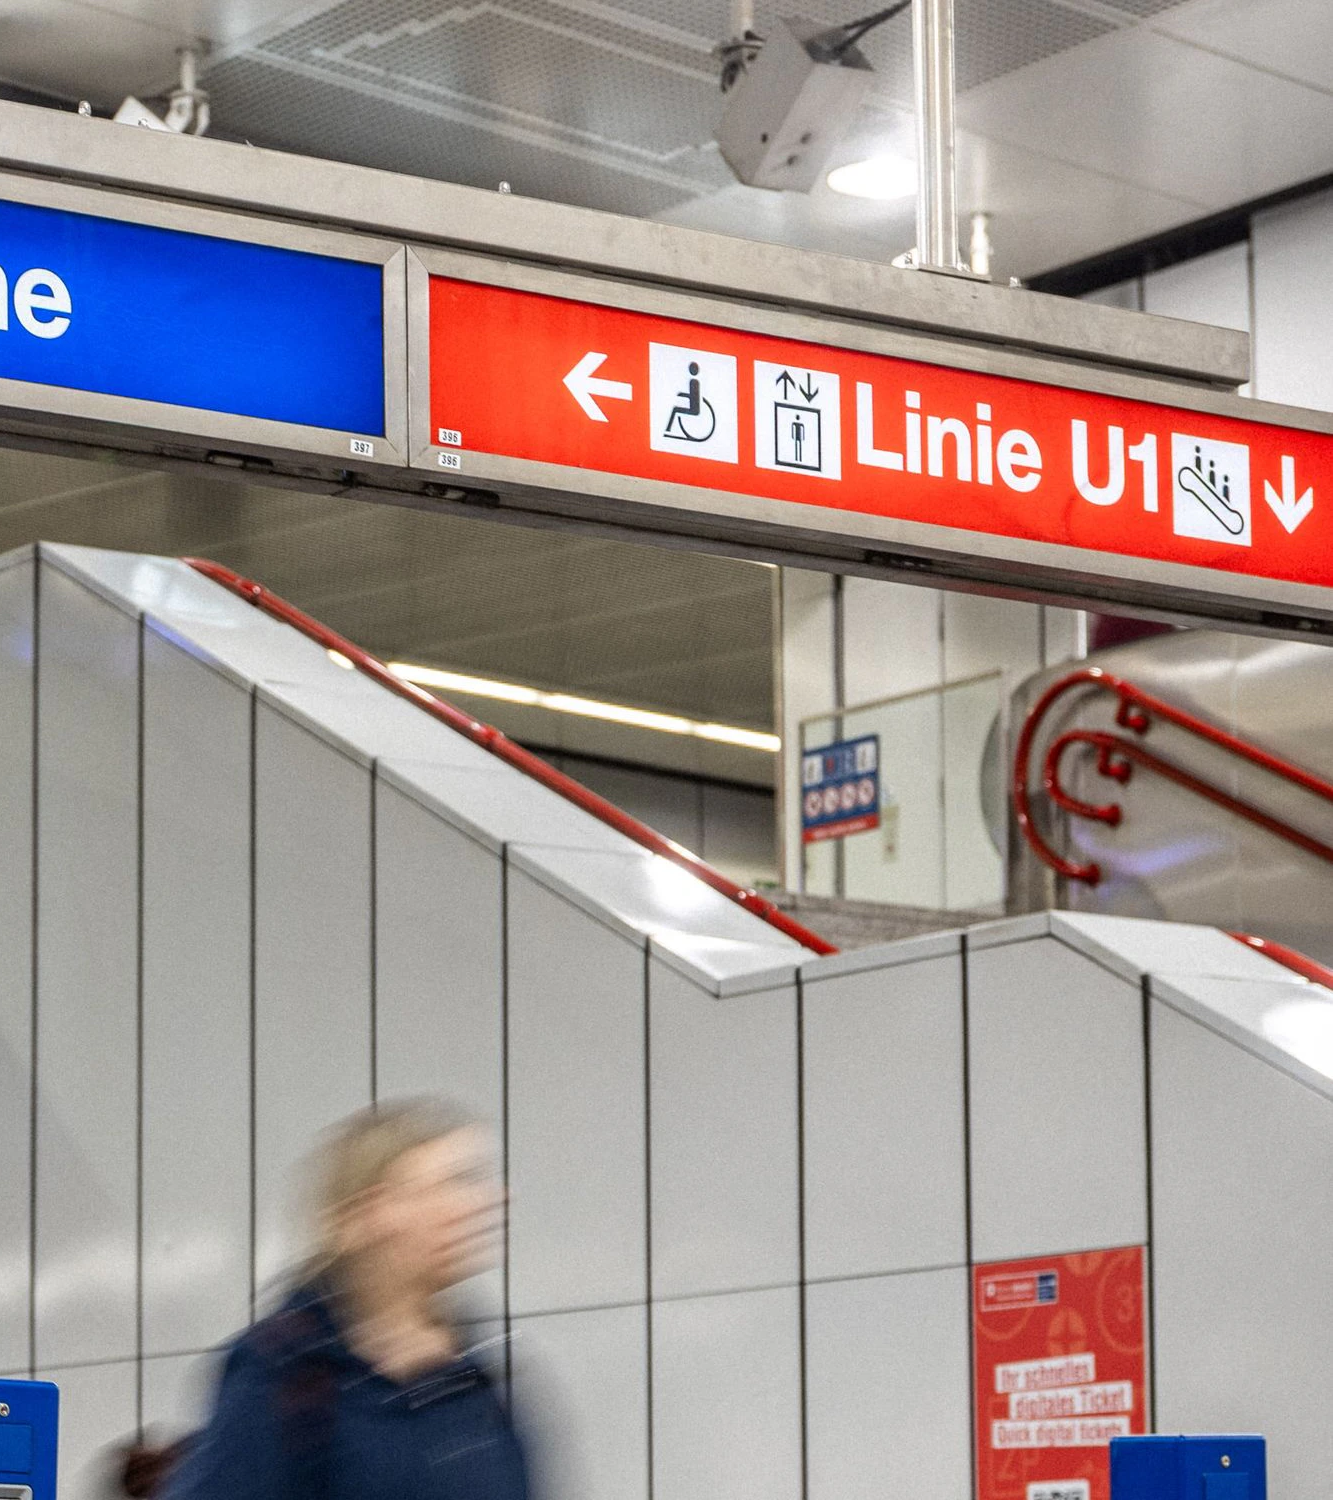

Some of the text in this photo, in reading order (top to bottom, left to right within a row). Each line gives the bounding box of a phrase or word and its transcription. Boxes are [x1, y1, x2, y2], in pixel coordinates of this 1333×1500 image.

[354, 441, 370, 454] 397
[856, 381, 1158, 513] Linie U1
[1001, 1362, 1089, 1389] Ihr schnelles
[1016, 1387, 1125, 1419] digitales Ticket
[998, 1422, 1122, 1445] Quick digital tickets
